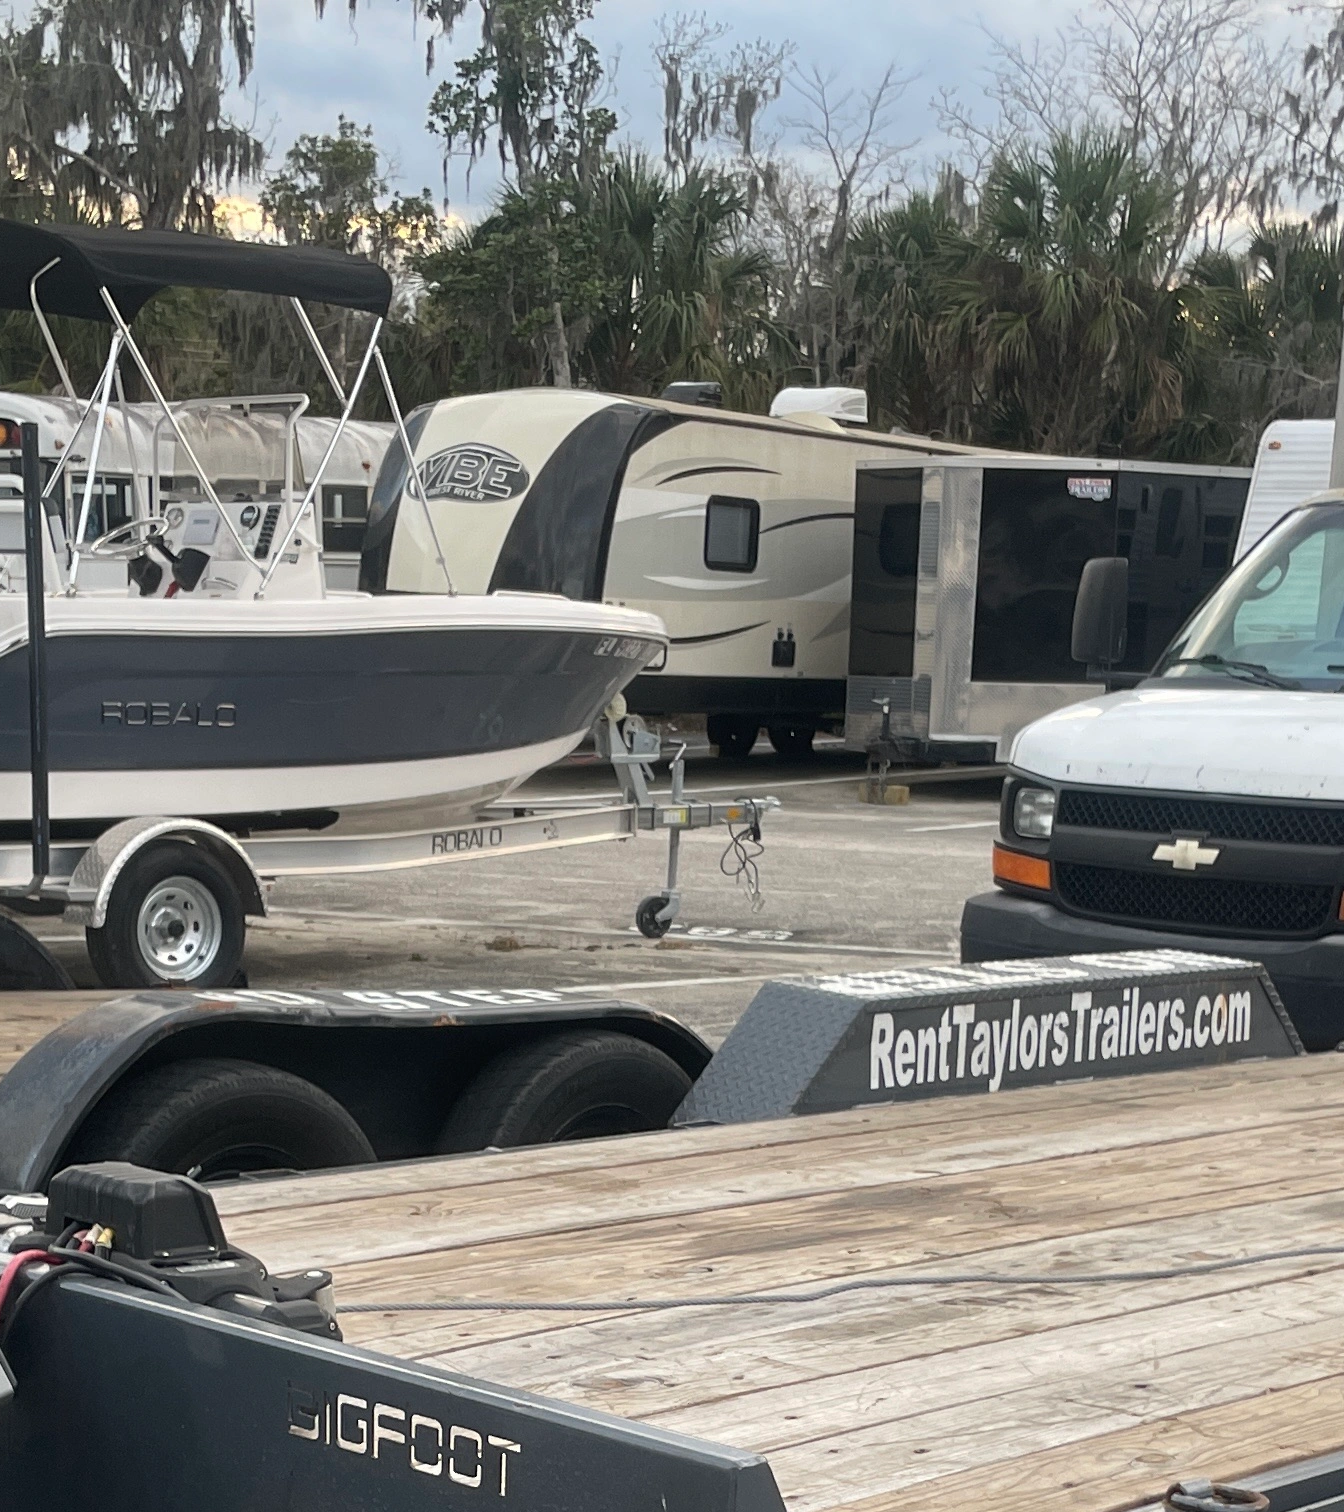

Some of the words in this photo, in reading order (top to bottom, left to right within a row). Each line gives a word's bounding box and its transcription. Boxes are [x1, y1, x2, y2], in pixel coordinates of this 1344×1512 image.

[416, 451, 522, 498] VIBE
[101, 701, 237, 727] ROBALO
[869, 986, 1252, 1092] RentTaylorsTrailers.com
[287, 1380, 522, 1497] BIGFOOT
